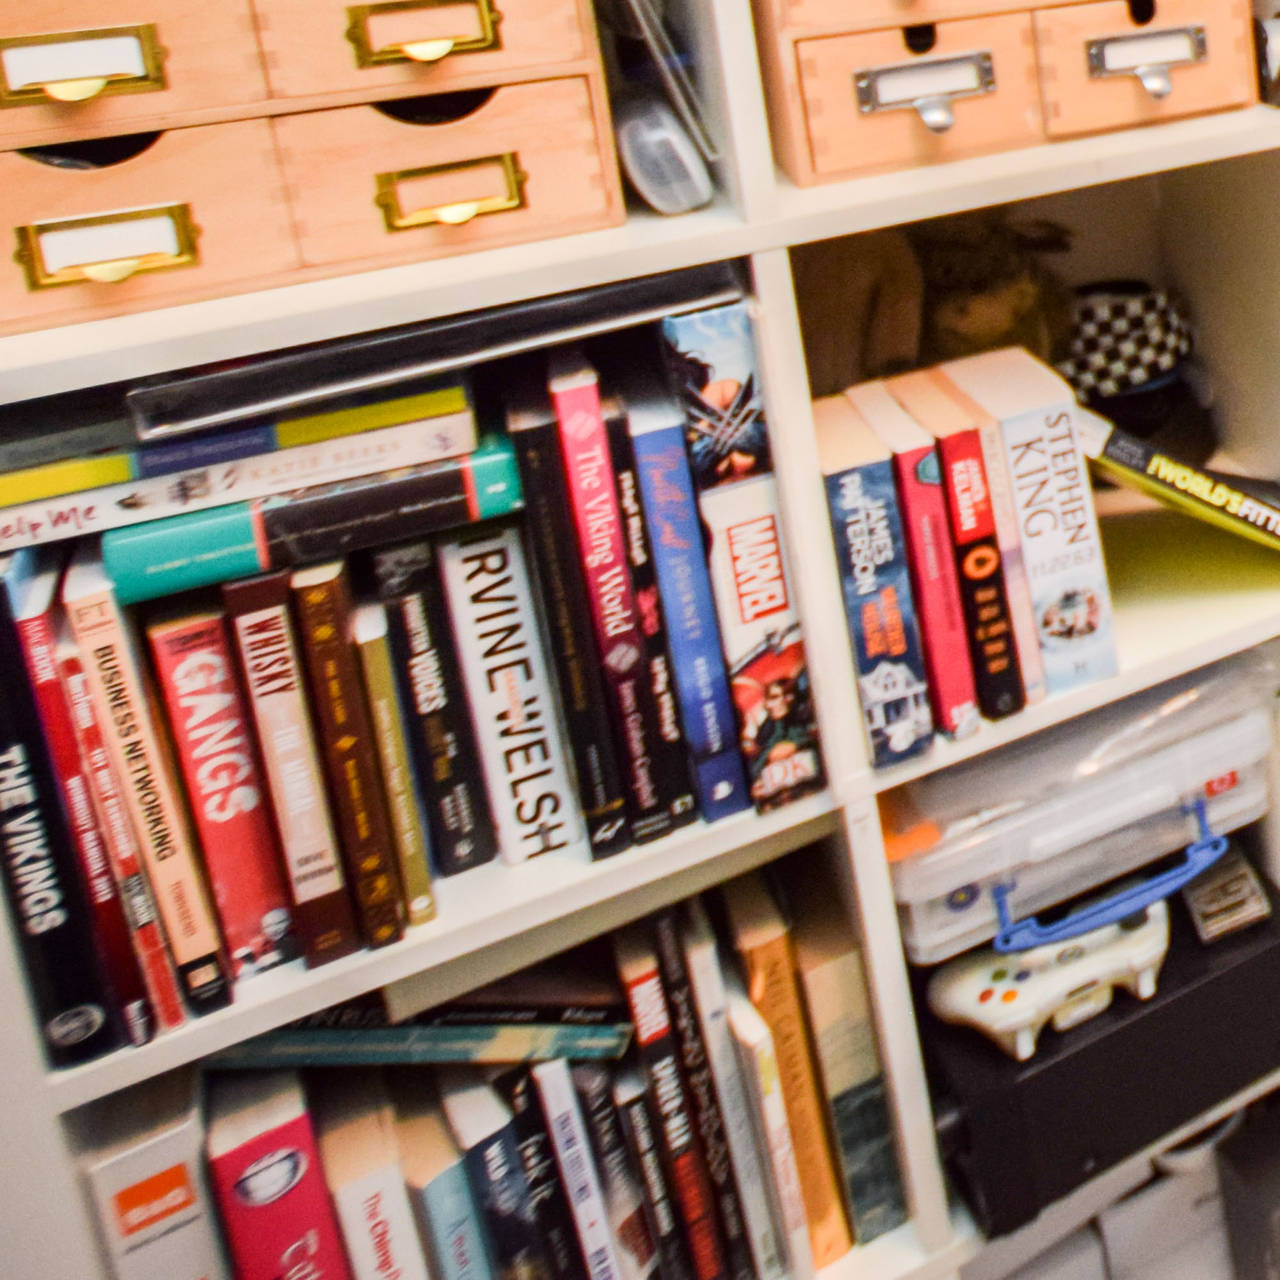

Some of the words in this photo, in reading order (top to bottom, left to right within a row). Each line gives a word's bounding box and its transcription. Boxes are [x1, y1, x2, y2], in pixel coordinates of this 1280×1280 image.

[577, 449, 602, 491] The
[1011, 436, 1058, 539] KING
[1045, 412, 1090, 546] STEPHEN
[1157, 455, 1246, 515] WORLD'S
[0, 512, 42, 543] elp
[584, 491, 619, 569] Viking
[839, 472, 878, 596] PATTERSON
[866, 497, 895, 566] JAMES
[597, 572, 636, 639] World
[731, 517, 787, 622] MARVEL
[245, 614, 299, 698] WHISKY
[407, 647, 449, 716] VOICES
[93, 643, 138, 739] BUSINESS
[122, 736, 177, 863] NETWORKING
[171, 650, 262, 824] GANGS
[0, 741, 39, 814] THE
[496, 695, 570, 861] WELSH
[2, 805, 70, 938] VIKINGS
[362, 1190, 386, 1221] The
[368, 1216, 400, 1277] Chimp
